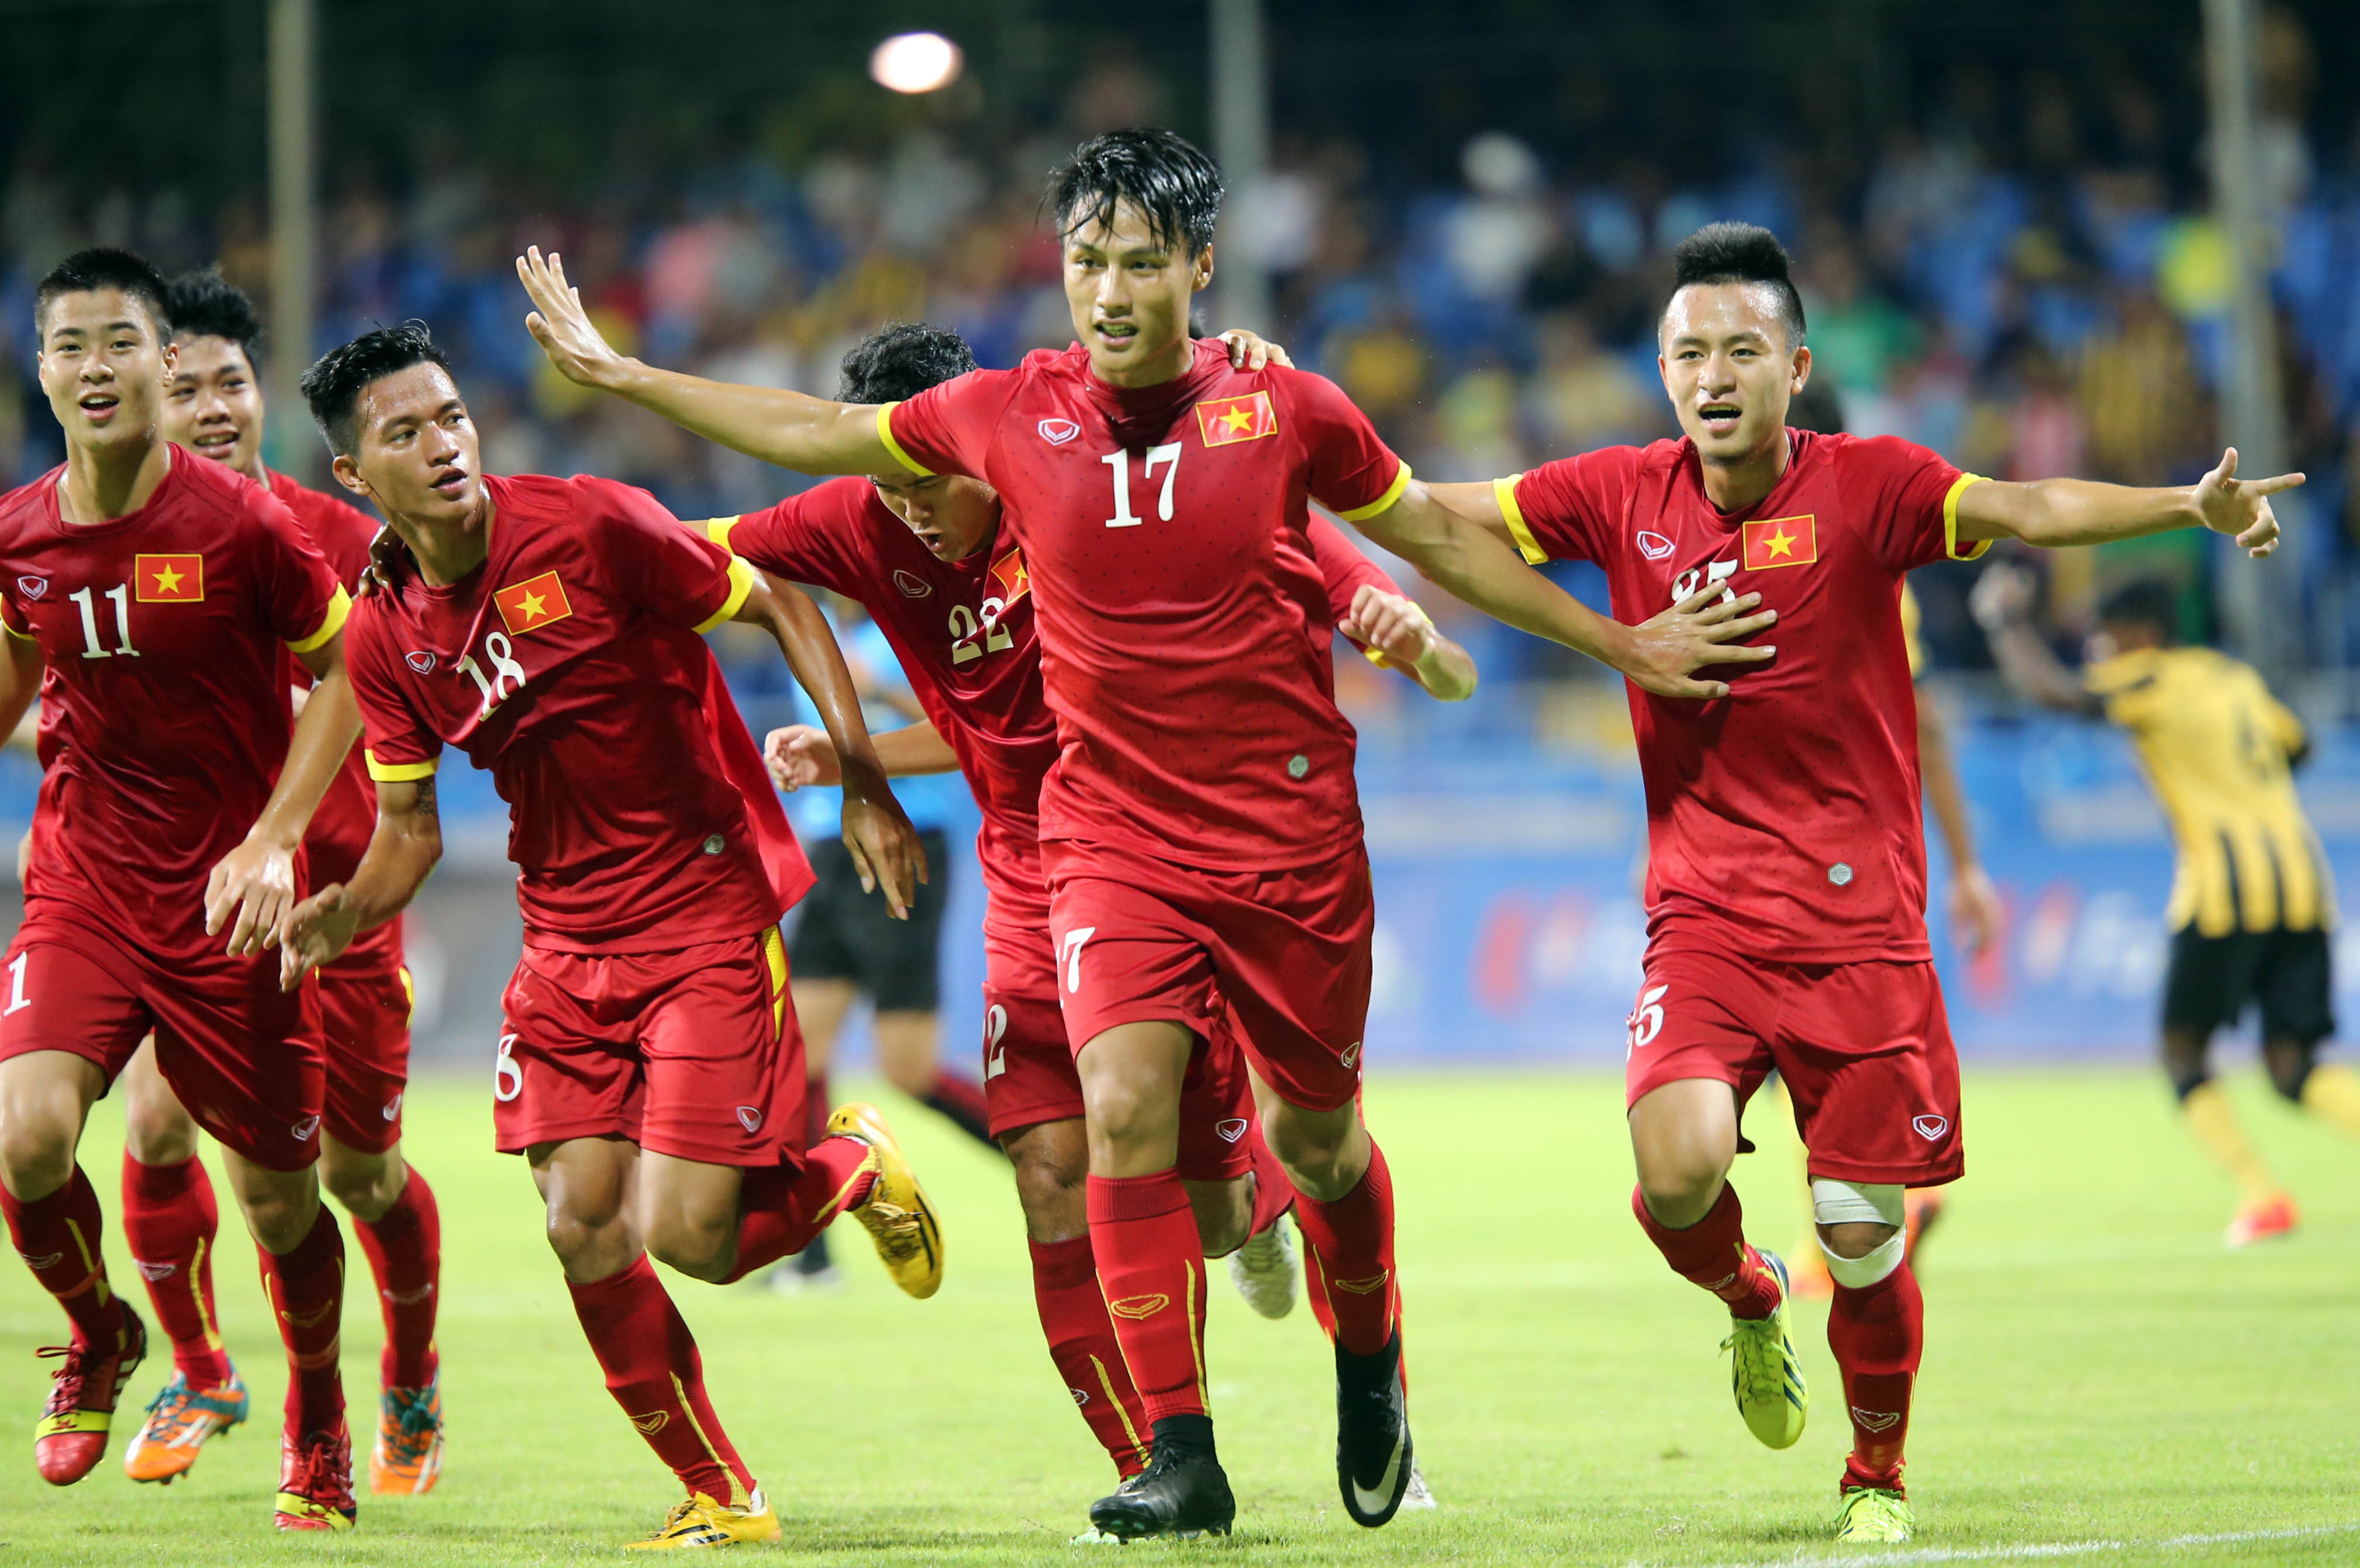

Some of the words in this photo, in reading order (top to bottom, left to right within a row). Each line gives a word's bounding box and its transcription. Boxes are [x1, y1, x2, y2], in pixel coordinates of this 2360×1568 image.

[1102, 441, 1182, 528] 17
[69, 583, 140, 658] 11
[948, 597, 1015, 665] 22
[456, 631, 526, 722] 18
[4, 951, 32, 1017] 1
[1055, 927, 1096, 1002] 7
[983, 1004, 1008, 1082] 2
